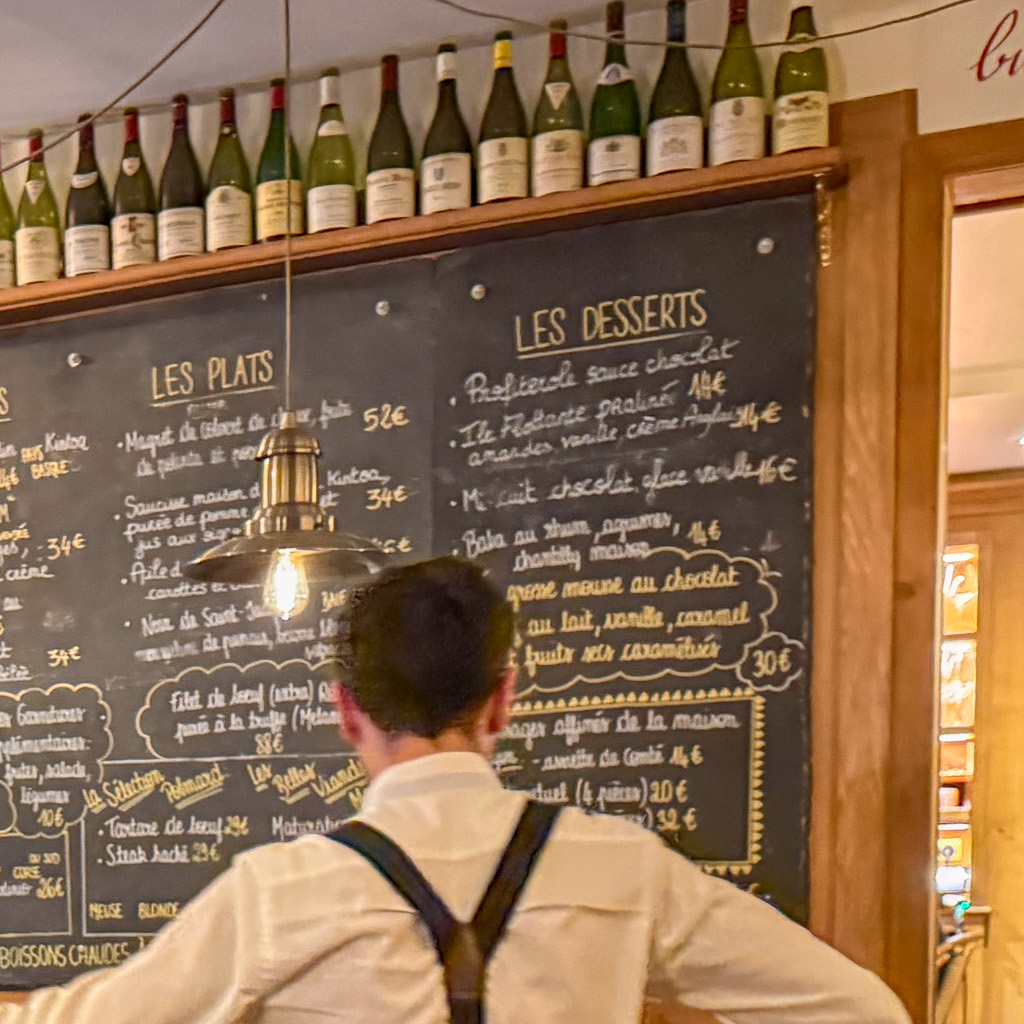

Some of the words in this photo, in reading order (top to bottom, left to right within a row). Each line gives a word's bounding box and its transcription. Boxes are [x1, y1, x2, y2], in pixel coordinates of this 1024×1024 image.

[516, 308, 566, 351] LES
[584, 289, 707, 342] DESSERTS
[645, 335, 741, 374] chocolat
[152, 361, 194, 400] LES
[207, 349, 274, 391] PLATS
[363, 404, 410, 432] 52€
[366, 485, 408, 510] 34€
[47, 533, 86, 560] 34€
[631, 575, 658, 593] au
[660, 564, 740, 592] chocolat
[528, 618, 555, 636] au
[47, 646, 82, 668] 34€
[646, 709, 668, 730] la
[106, 845, 147, 866] Steak
